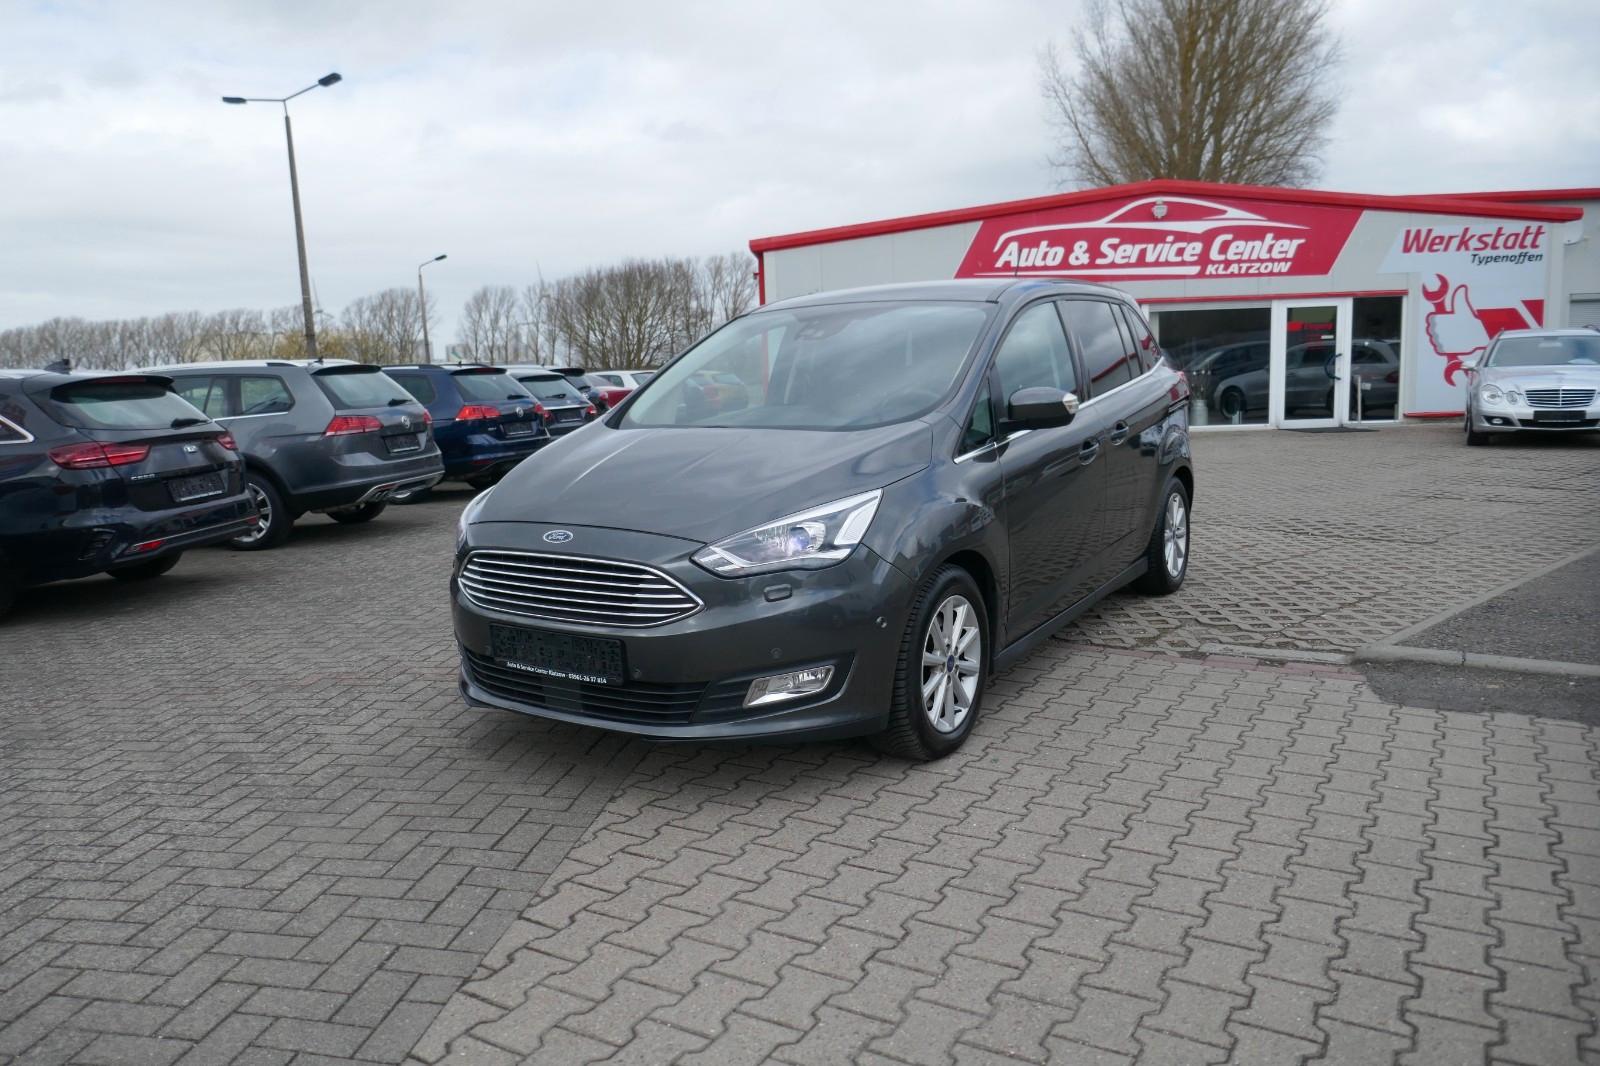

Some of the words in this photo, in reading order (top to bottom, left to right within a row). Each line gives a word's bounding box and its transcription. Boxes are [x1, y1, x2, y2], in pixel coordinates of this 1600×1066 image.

[1402, 225, 1545, 253] Werkstatt
[994, 240, 1065, 268] Auto
[1068, 240, 1090, 266] &
[1095, 235, 1203, 265] Service
[1209, 232, 1306, 261] Center
[1471, 252, 1543, 265] Typenoffen
[1205, 261, 1292, 275] KLATZOW
[546, 531, 571, 542] Ford
